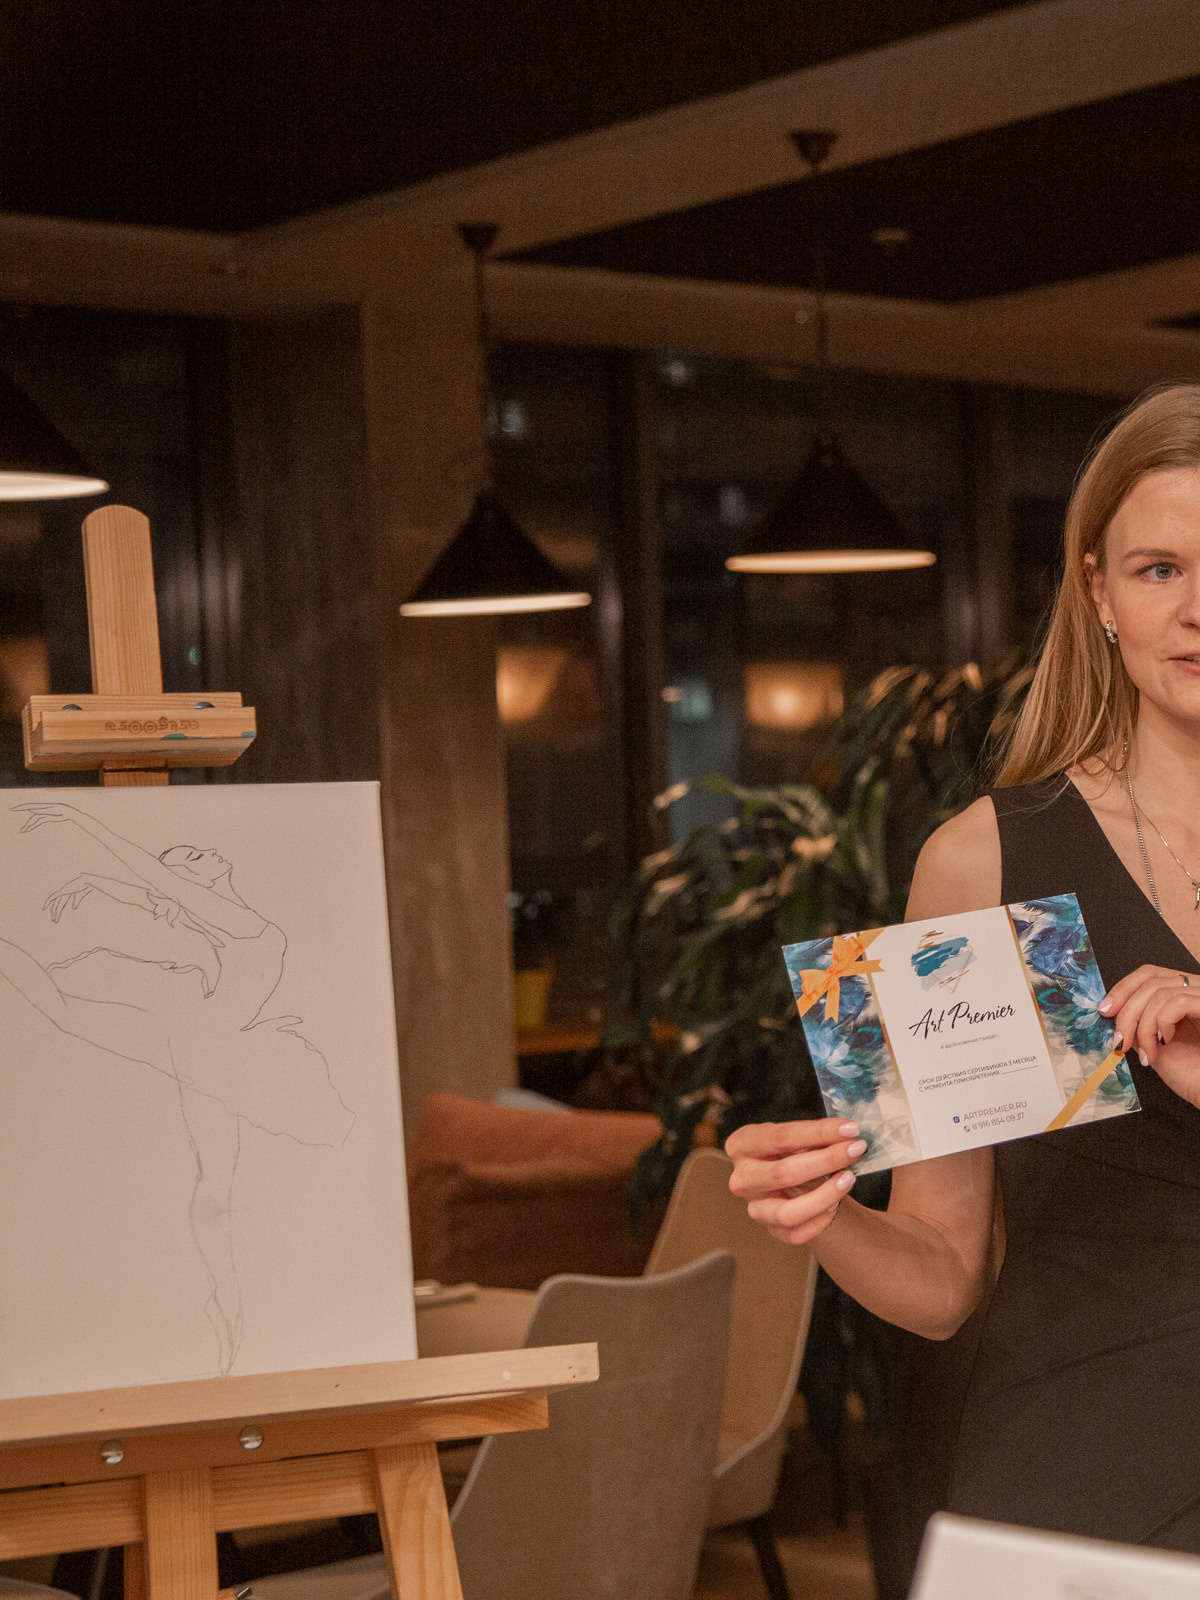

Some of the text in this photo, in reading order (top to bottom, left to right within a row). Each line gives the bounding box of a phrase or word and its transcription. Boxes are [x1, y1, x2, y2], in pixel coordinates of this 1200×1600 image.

[908, 1001, 1016, 1040] Art Premier
[918, 1077, 935, 1086] СРОК
[935, 1070, 967, 1083] ДЕЙСТВИЯ
[967, 1062, 1008, 1074] СЕРТИФИКАТА
[1012, 1055, 1037, 1065] МЕСЯЦА
[924, 1080, 953, 1091] МОМЕНТА
[953, 1070, 1000, 1085] ПРИОБРЕТЕНИЯ
[963, 1101, 1027, 1121] ARTPREMIER.RU
[978, 1120, 991, 1129] 916
[991, 1117, 1005, 1126] 854
[1005, 1115, 1016, 1123] 09
[1016, 1112, 1024, 1120] 37
